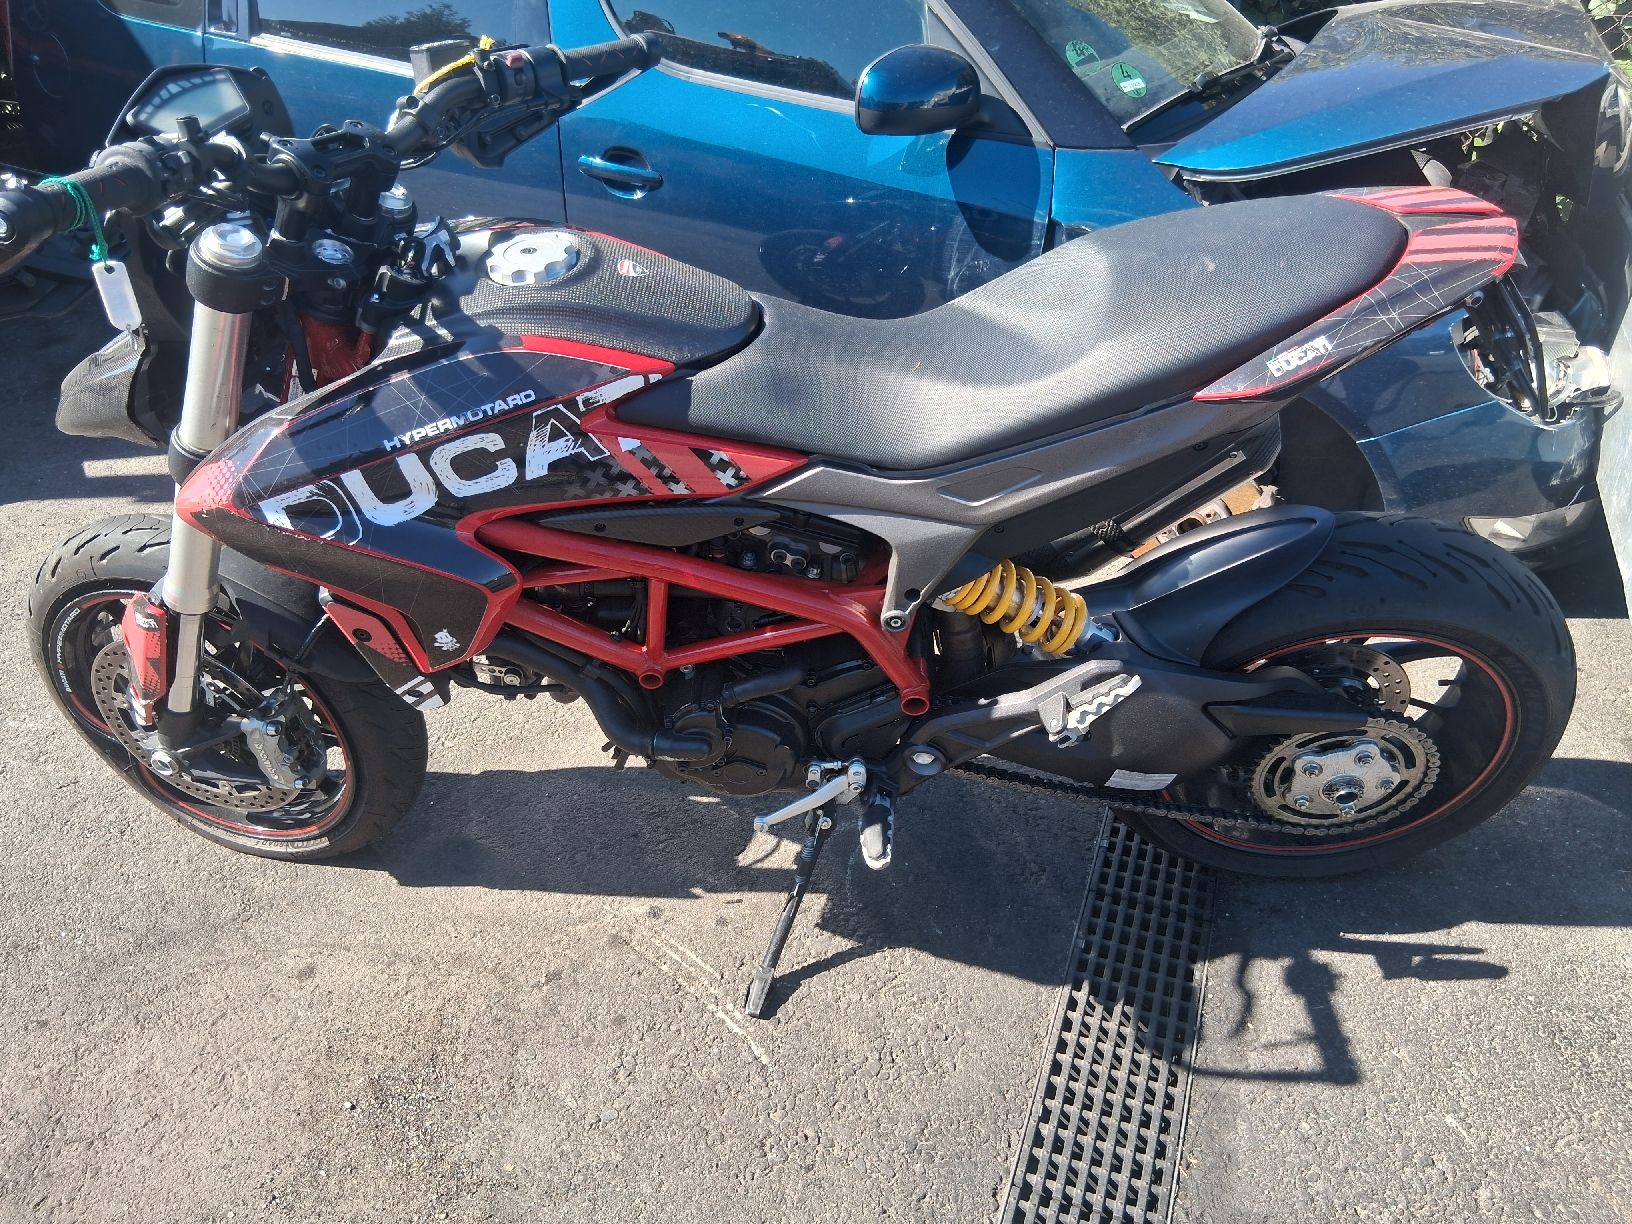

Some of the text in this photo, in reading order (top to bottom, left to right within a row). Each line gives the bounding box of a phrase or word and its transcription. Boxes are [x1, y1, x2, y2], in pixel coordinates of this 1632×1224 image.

[1119, 64, 1132, 79] 4
[1266, 335, 1332, 377] DUCATI
[383, 389, 536, 451] HYPERMOTARD
[57, 607, 81, 664] HYPERMOTARD
